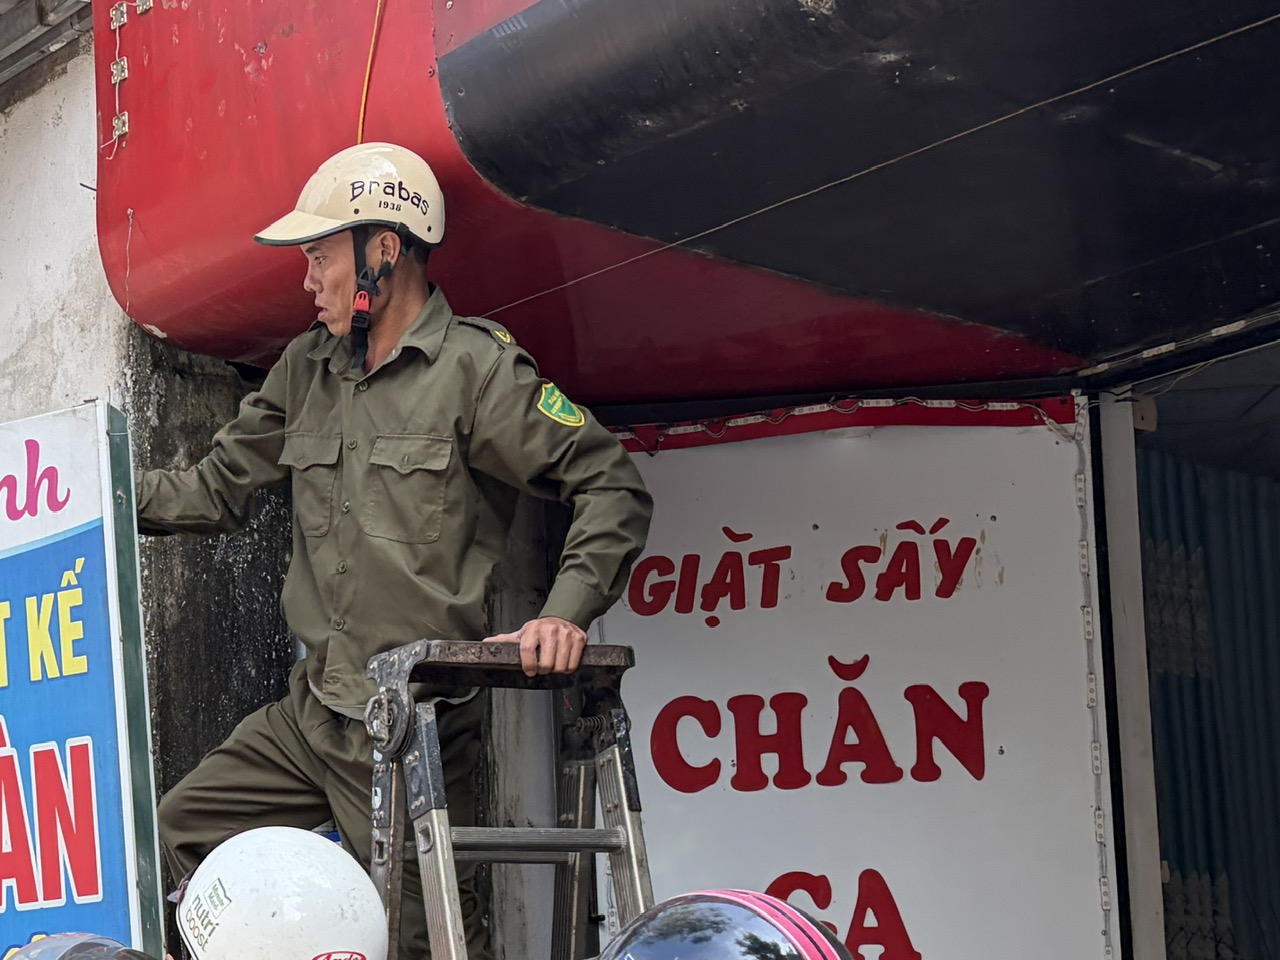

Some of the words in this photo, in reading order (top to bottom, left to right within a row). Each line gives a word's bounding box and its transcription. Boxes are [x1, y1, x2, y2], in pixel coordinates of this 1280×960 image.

[349, 180, 430, 216] Brabas
[378, 200, 402, 212] 1938
[627, 525, 792, 628] GIẶT
[825, 516, 977, 604] SẤY
[25, 557, 89, 682] KẾ
[650, 653, 990, 793] CHĂN
[192, 894, 219, 937] nutri
